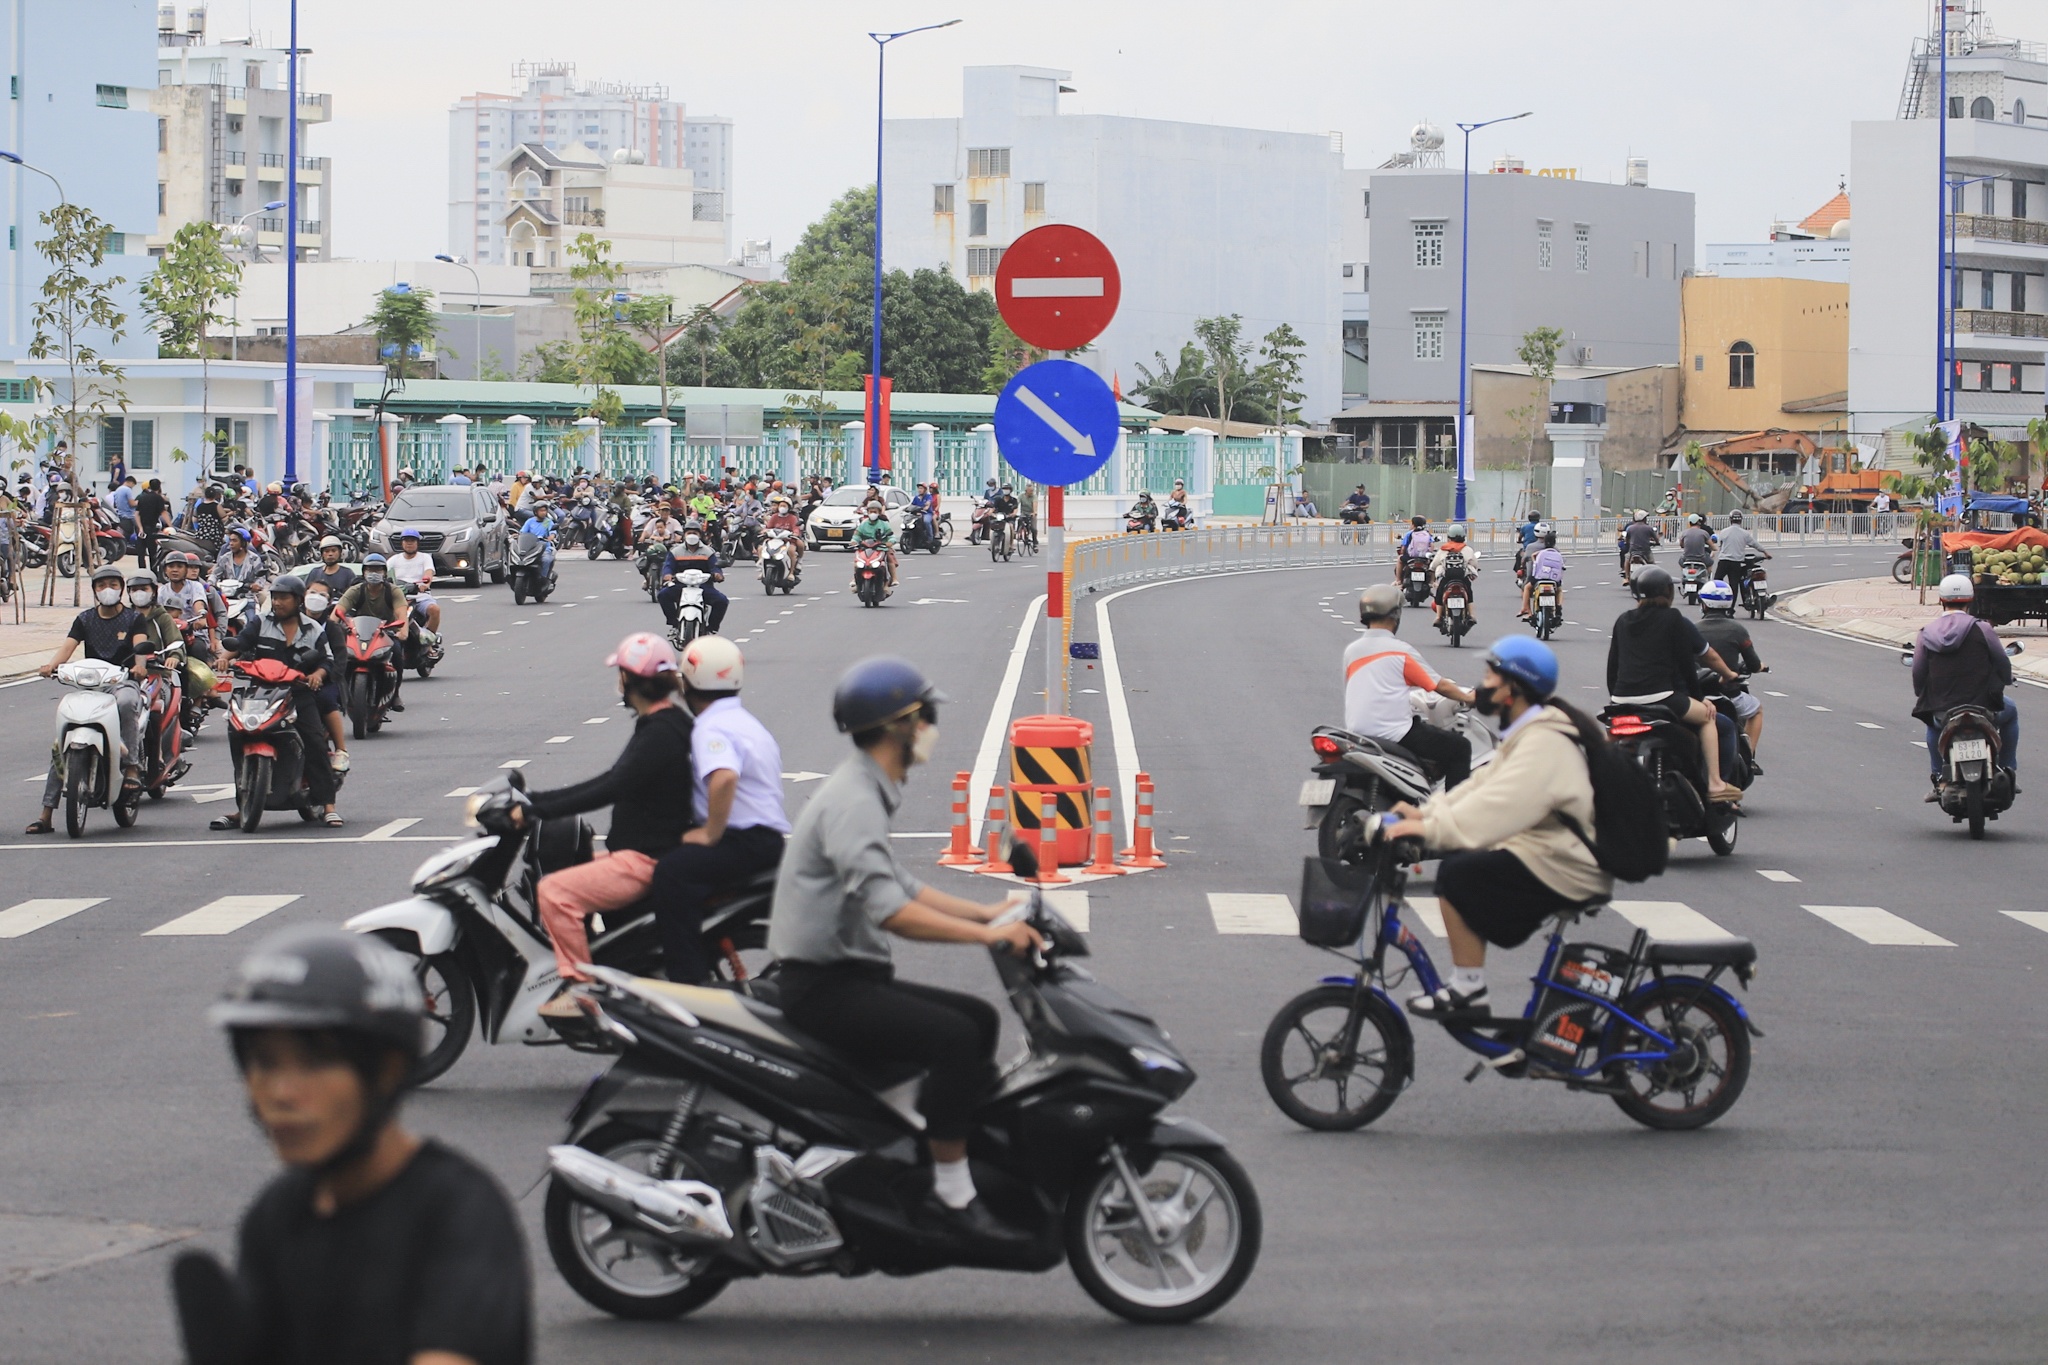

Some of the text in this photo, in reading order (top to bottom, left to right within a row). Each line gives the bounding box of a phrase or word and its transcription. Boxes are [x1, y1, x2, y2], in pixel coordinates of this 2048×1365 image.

[511, 58, 576, 78] LÊ THÀNH
[1959, 750, 1982, 759] 3420
